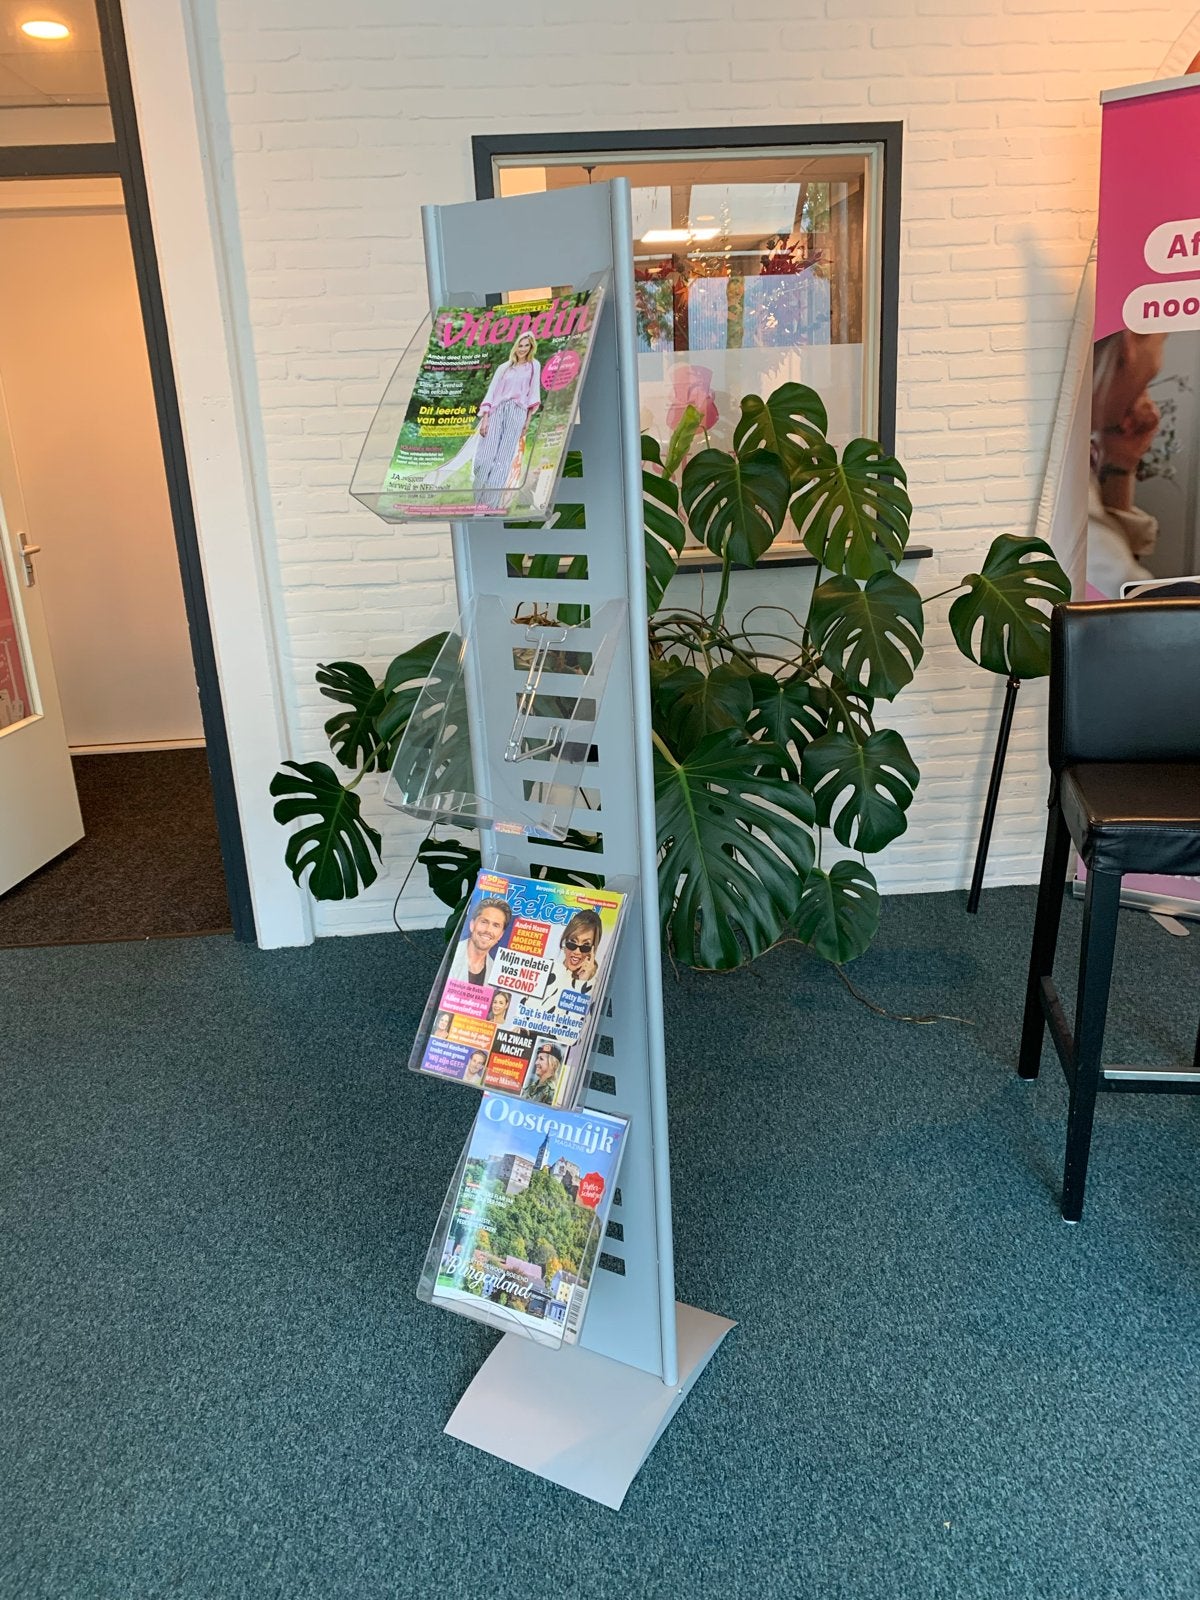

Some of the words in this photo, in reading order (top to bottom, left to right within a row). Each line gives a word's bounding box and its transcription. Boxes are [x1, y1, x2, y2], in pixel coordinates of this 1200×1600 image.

[1143, 297, 1200, 319] noo
[438, 297, 591, 349] Vriendin
[419, 405, 434, 415] Dit
[436, 406, 467, 415] leerde
[469, 405, 478, 414] ik
[417, 416, 435, 424] van
[437, 415, 477, 424] ontrouw
[487, 873, 498, 882] 50
[514, 921, 532, 931] André
[532, 924, 549, 934] Hazes
[517, 929, 544, 940] ERKENT
[512, 935, 544, 947] MOEDER-
[510, 942, 543, 956] COMPLEX
[499, 949, 520, 966] 'Mijn
[520, 957, 550, 973] relatie
[501, 964, 519, 976] was
[519, 968, 541, 982] NIET
[497, 974, 539, 993] GEZOND'
[561, 991, 577, 1002] Patty
[560, 1000, 574, 1011] vindt
[573, 1004, 586, 1013] rust
[518, 1004, 535, 1017] 'Dat
[534, 1009, 542, 1018] is
[541, 1010, 556, 1022] het
[555, 1014, 584, 1029] lekkere
[512, 1017, 528, 1027] aan
[528, 1020, 550, 1032] ouder
[497, 1031, 508, 1043] NA
[507, 1034, 533, 1048] ZWARE
[499, 1043, 525, 1057] NACHT
[484, 1097, 616, 1154] Oostenrijk
[446, 1254, 533, 1299] Burgenland
